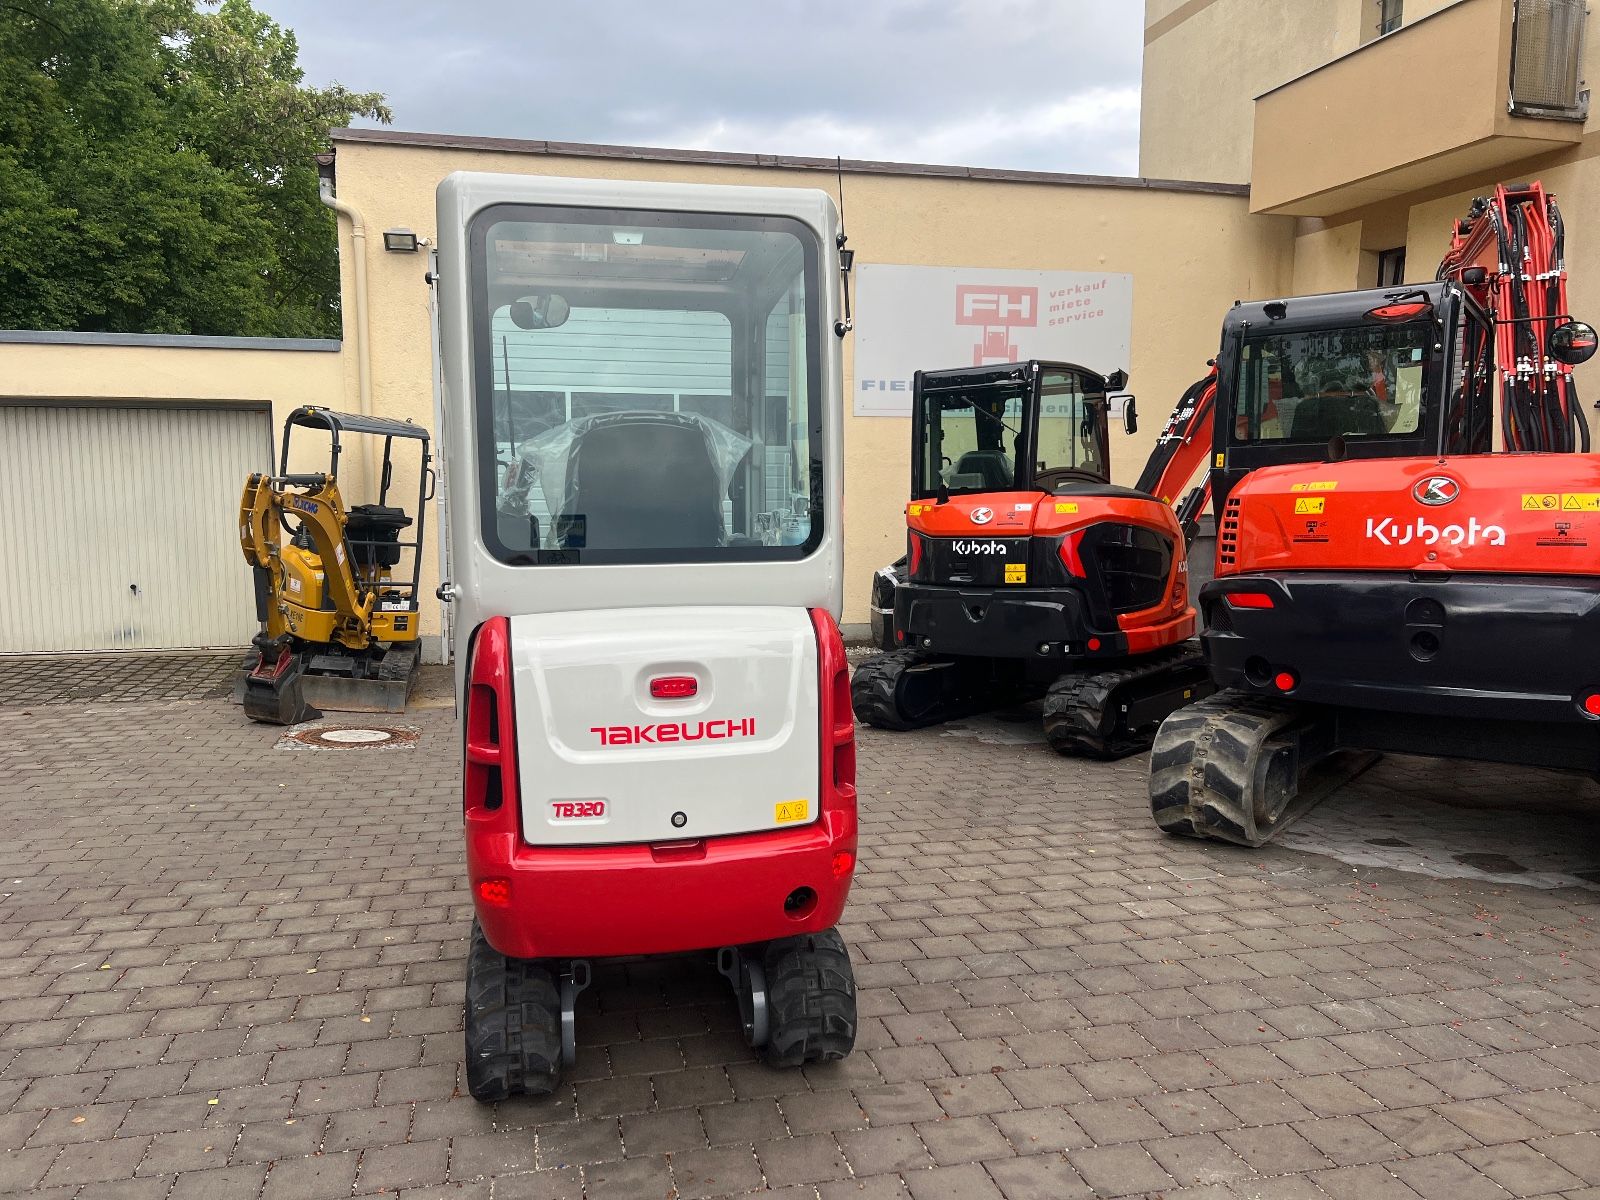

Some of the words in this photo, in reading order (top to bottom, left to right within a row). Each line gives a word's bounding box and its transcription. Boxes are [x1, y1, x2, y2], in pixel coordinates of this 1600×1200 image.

[1049, 279, 1107, 299] verkauf
[963, 293, 1031, 319] FH
[1049, 297, 1092, 313] miete
[1048, 308, 1105, 327] service
[861, 379, 914, 392] FIE
[1365, 516, 1507, 546] Kubota
[952, 540, 1007, 555] Kubota
[551, 801, 605, 819] TB320
